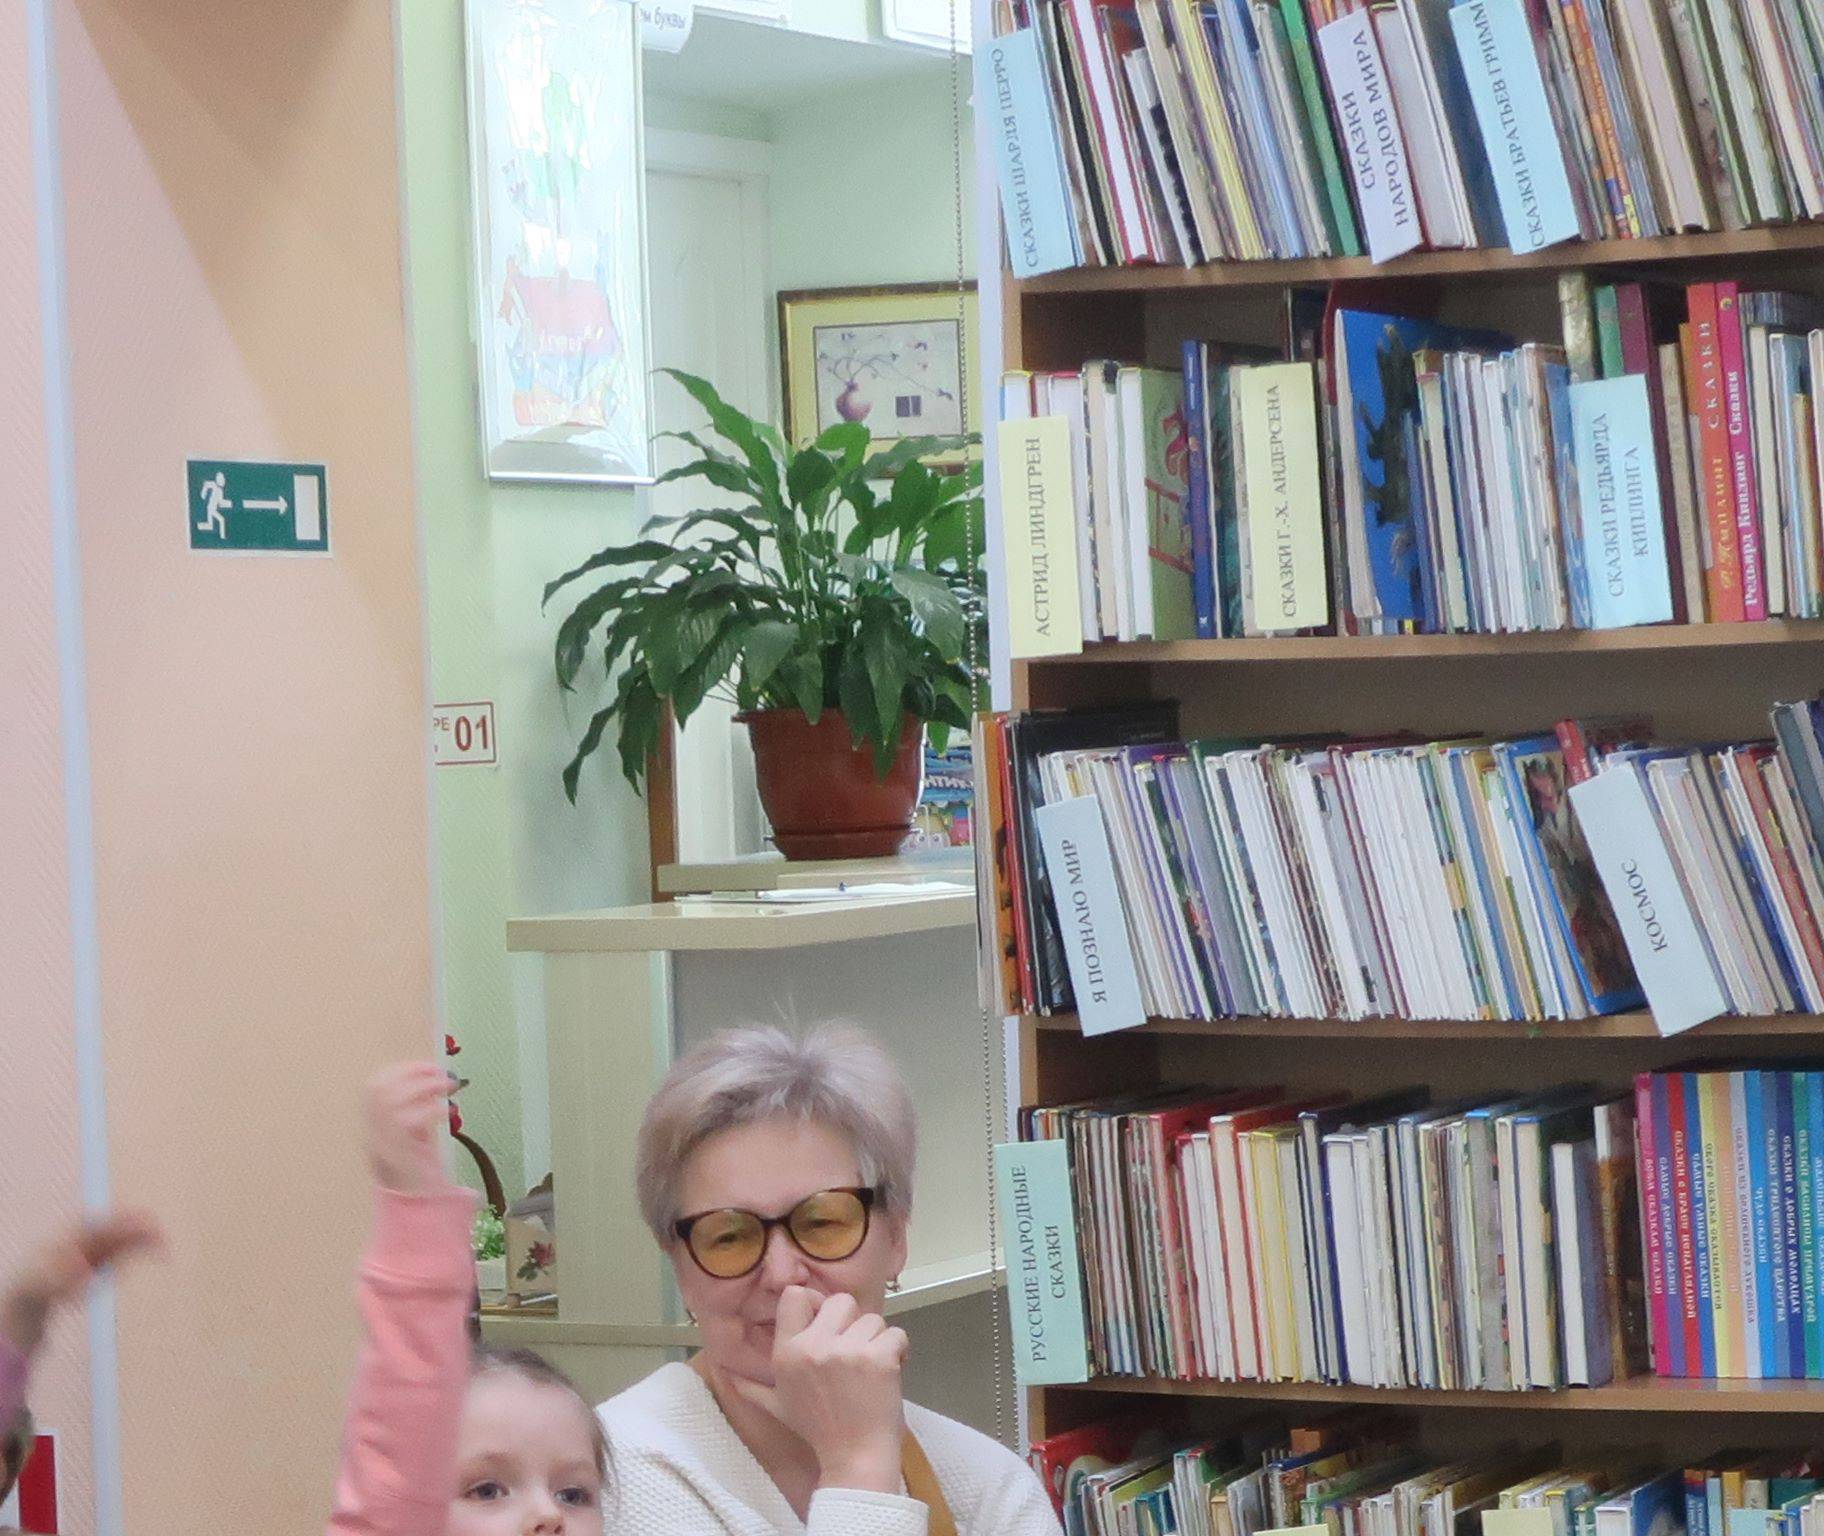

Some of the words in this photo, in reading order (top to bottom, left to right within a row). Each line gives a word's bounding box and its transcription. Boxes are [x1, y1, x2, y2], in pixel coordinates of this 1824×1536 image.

[1352, 30, 1382, 104] МИРА
[1469, 2, 1502, 75] ГРИММ
[991, 48, 1013, 111] ПЕРРО
[1002, 115, 1026, 186] ШАРЛЯ
[1341, 91, 1376, 193] СКАЗКИ
[1492, 78, 1526, 166] БРАТЬЕВ
[1372, 108, 1409, 227] НАРОДОВ
[1015, 190, 1039, 268] СКАЗКИ
[1515, 168, 1545, 248] СКАЗКИ
[1700, 321, 1719, 429] СКАЗКИ
[1724, 370, 1743, 435] Сказки
[1265, 383, 1287, 495] АНДЕРСЕНА
[1590, 413, 1616, 514] РЕДЬЯРДА
[1025, 438, 1047, 549] ЛИНДГРЕН
[1624, 446, 1649, 557] КИПЛИНГА
[1031, 553, 1050, 637] АСТРИД
[1278, 545, 1296, 618] СКАЗКИ
[1600, 519, 1623, 597] СКАЗКИ
[455, 715, 489, 751] 01
[1061, 839, 1082, 885] МИР
[1072, 890, 1104, 985] ПОЗНАЮ
[1625, 864, 1668, 952] КОСМОС
[1092, 990, 1107, 1003] Я
[1674, 1130, 1686, 1176] СКАЗКИ
[1766, 1129, 1778, 1175] СКАЗКИ
[1781, 1135, 1793, 1182] СКАЗКИ
[1797, 1129, 1809, 1175] СКАЗКИ
[1011, 1167, 1037, 1271] НАРОДНЫЕ
[1707, 1182, 1717, 1223] СКАЗКА
[1769, 1180, 1782, 1263] ТРИДЕСЯТОГО
[1784, 1198, 1796, 1244] ДОБРЫХ
[1044, 1225, 1066, 1299] СКАЗКИ
[1664, 1251, 1676, 1295] СКАЗКИ
[1697, 1252, 1709, 1298] СКАЗКИ
[1773, 1267, 1785, 1322] ЦАРСТВА
[1787, 1248, 1800, 1313] МОЛОДЦАХ
[1024, 1281, 1047, 1362] РУССКИЕ
